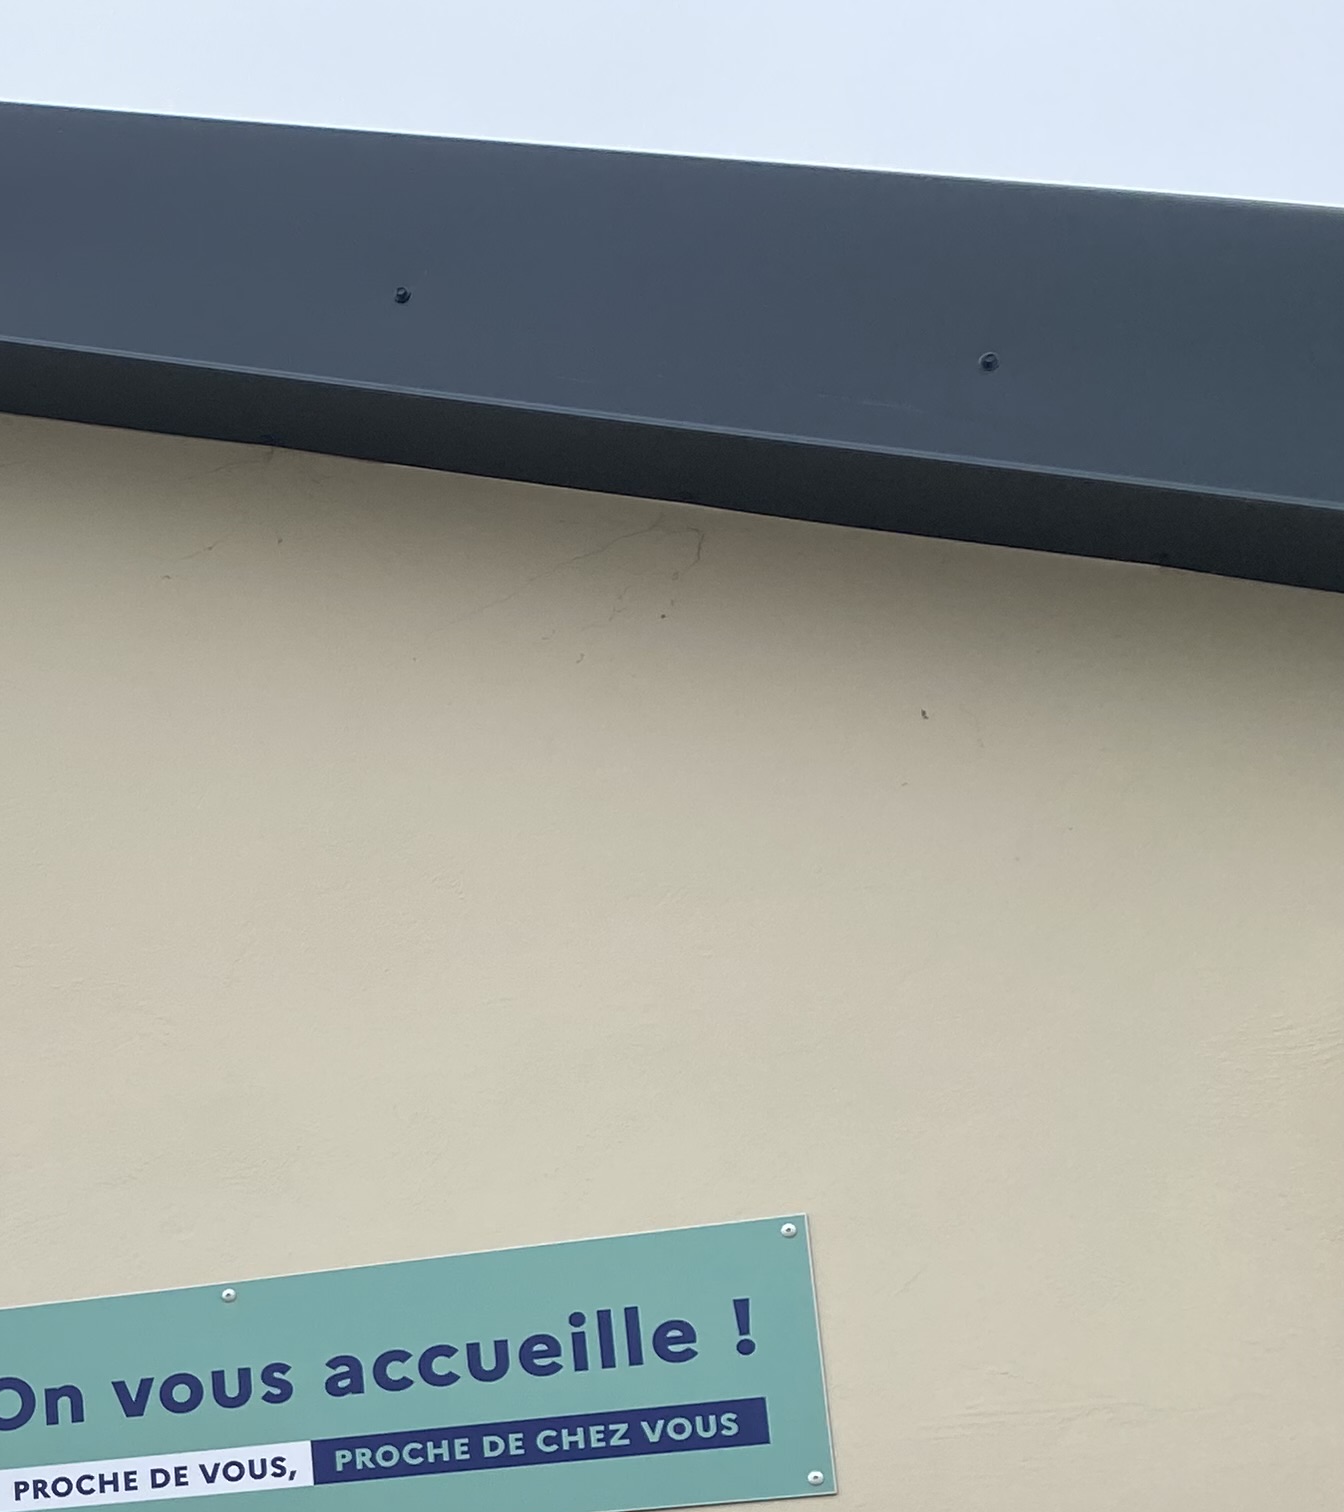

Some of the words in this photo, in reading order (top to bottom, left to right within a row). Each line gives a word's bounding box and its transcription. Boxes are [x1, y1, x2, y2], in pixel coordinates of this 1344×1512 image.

[112, 1362, 294, 1418] vous
[324, 1306, 699, 1398] accueille
[732, 1297, 756, 1356] !
[13, 1471, 138, 1501] PROCHE
[150, 1467, 189, 1488] DE
[198, 1456, 297, 1484] VOUS,
[335, 1438, 470, 1472] PROCHE
[482, 1432, 524, 1458] DE
[536, 1422, 629, 1454] CHEZ
[640, 1411, 739, 1443] VOUS
